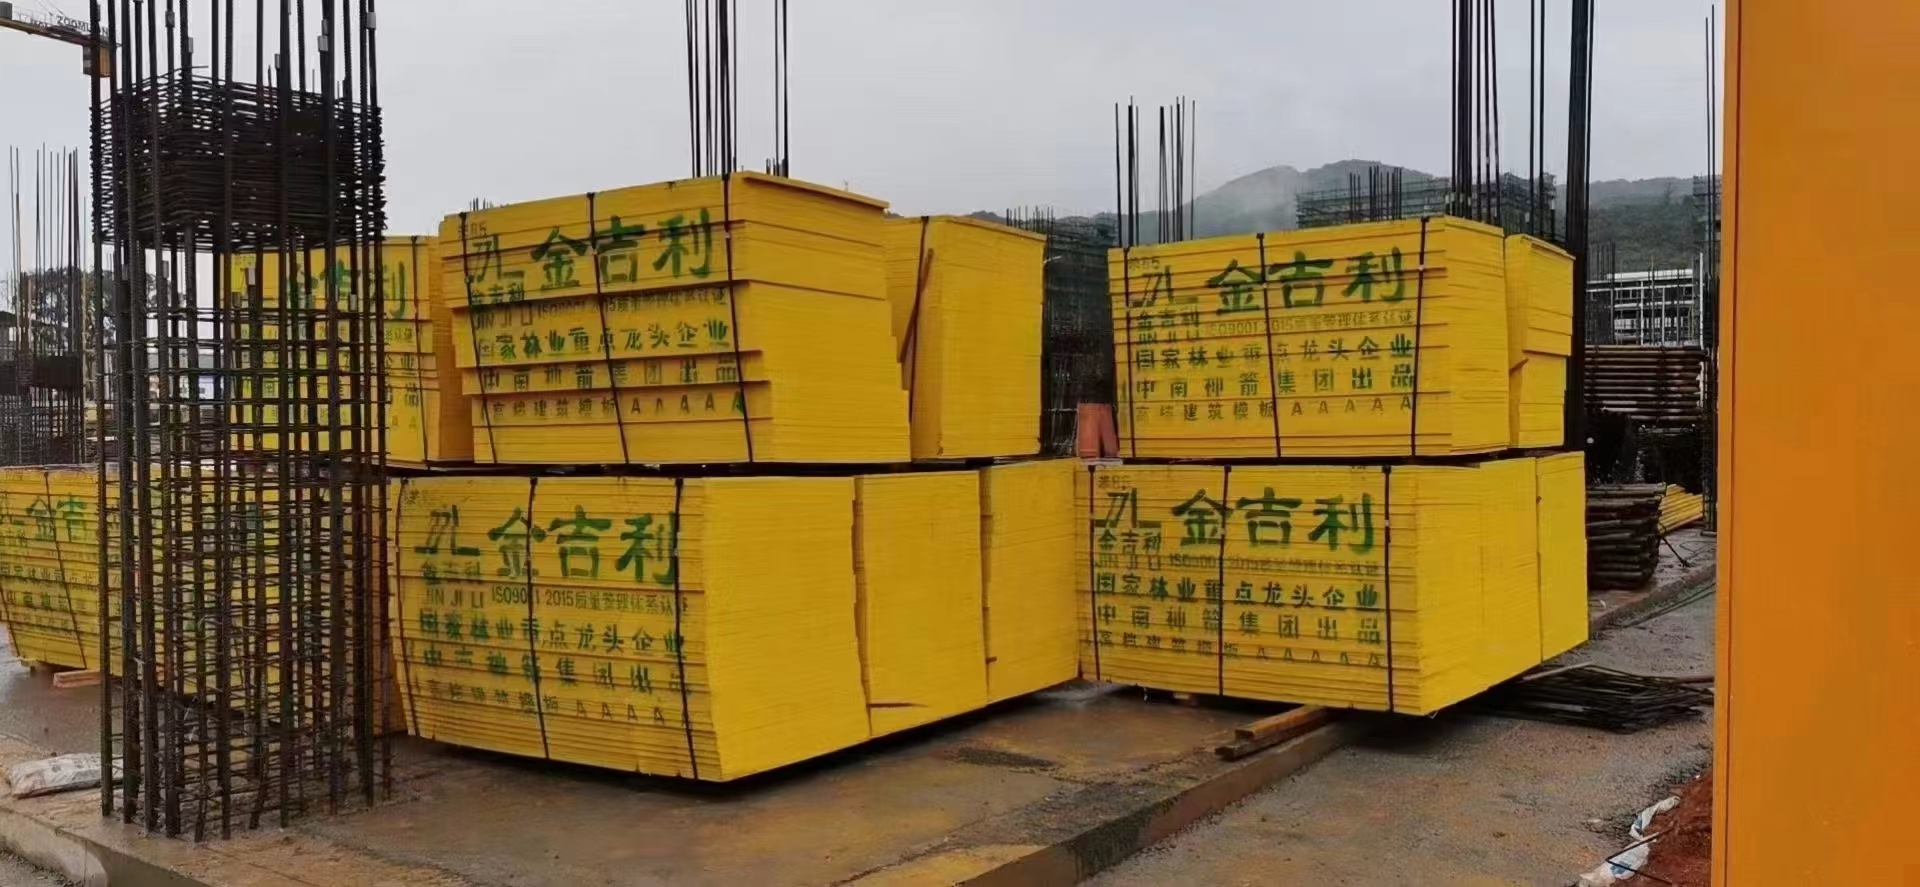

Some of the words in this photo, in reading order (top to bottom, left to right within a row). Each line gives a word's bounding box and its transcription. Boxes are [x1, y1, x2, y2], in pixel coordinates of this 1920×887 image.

[531, 207, 713, 289] 金吉利
[1205, 246, 1406, 316] 金吉利
[487, 504, 677, 586] 金吉利
[1171, 487, 1374, 555] 金吉利
[1096, 573, 1381, 612] 国家林业重点龙头企业
